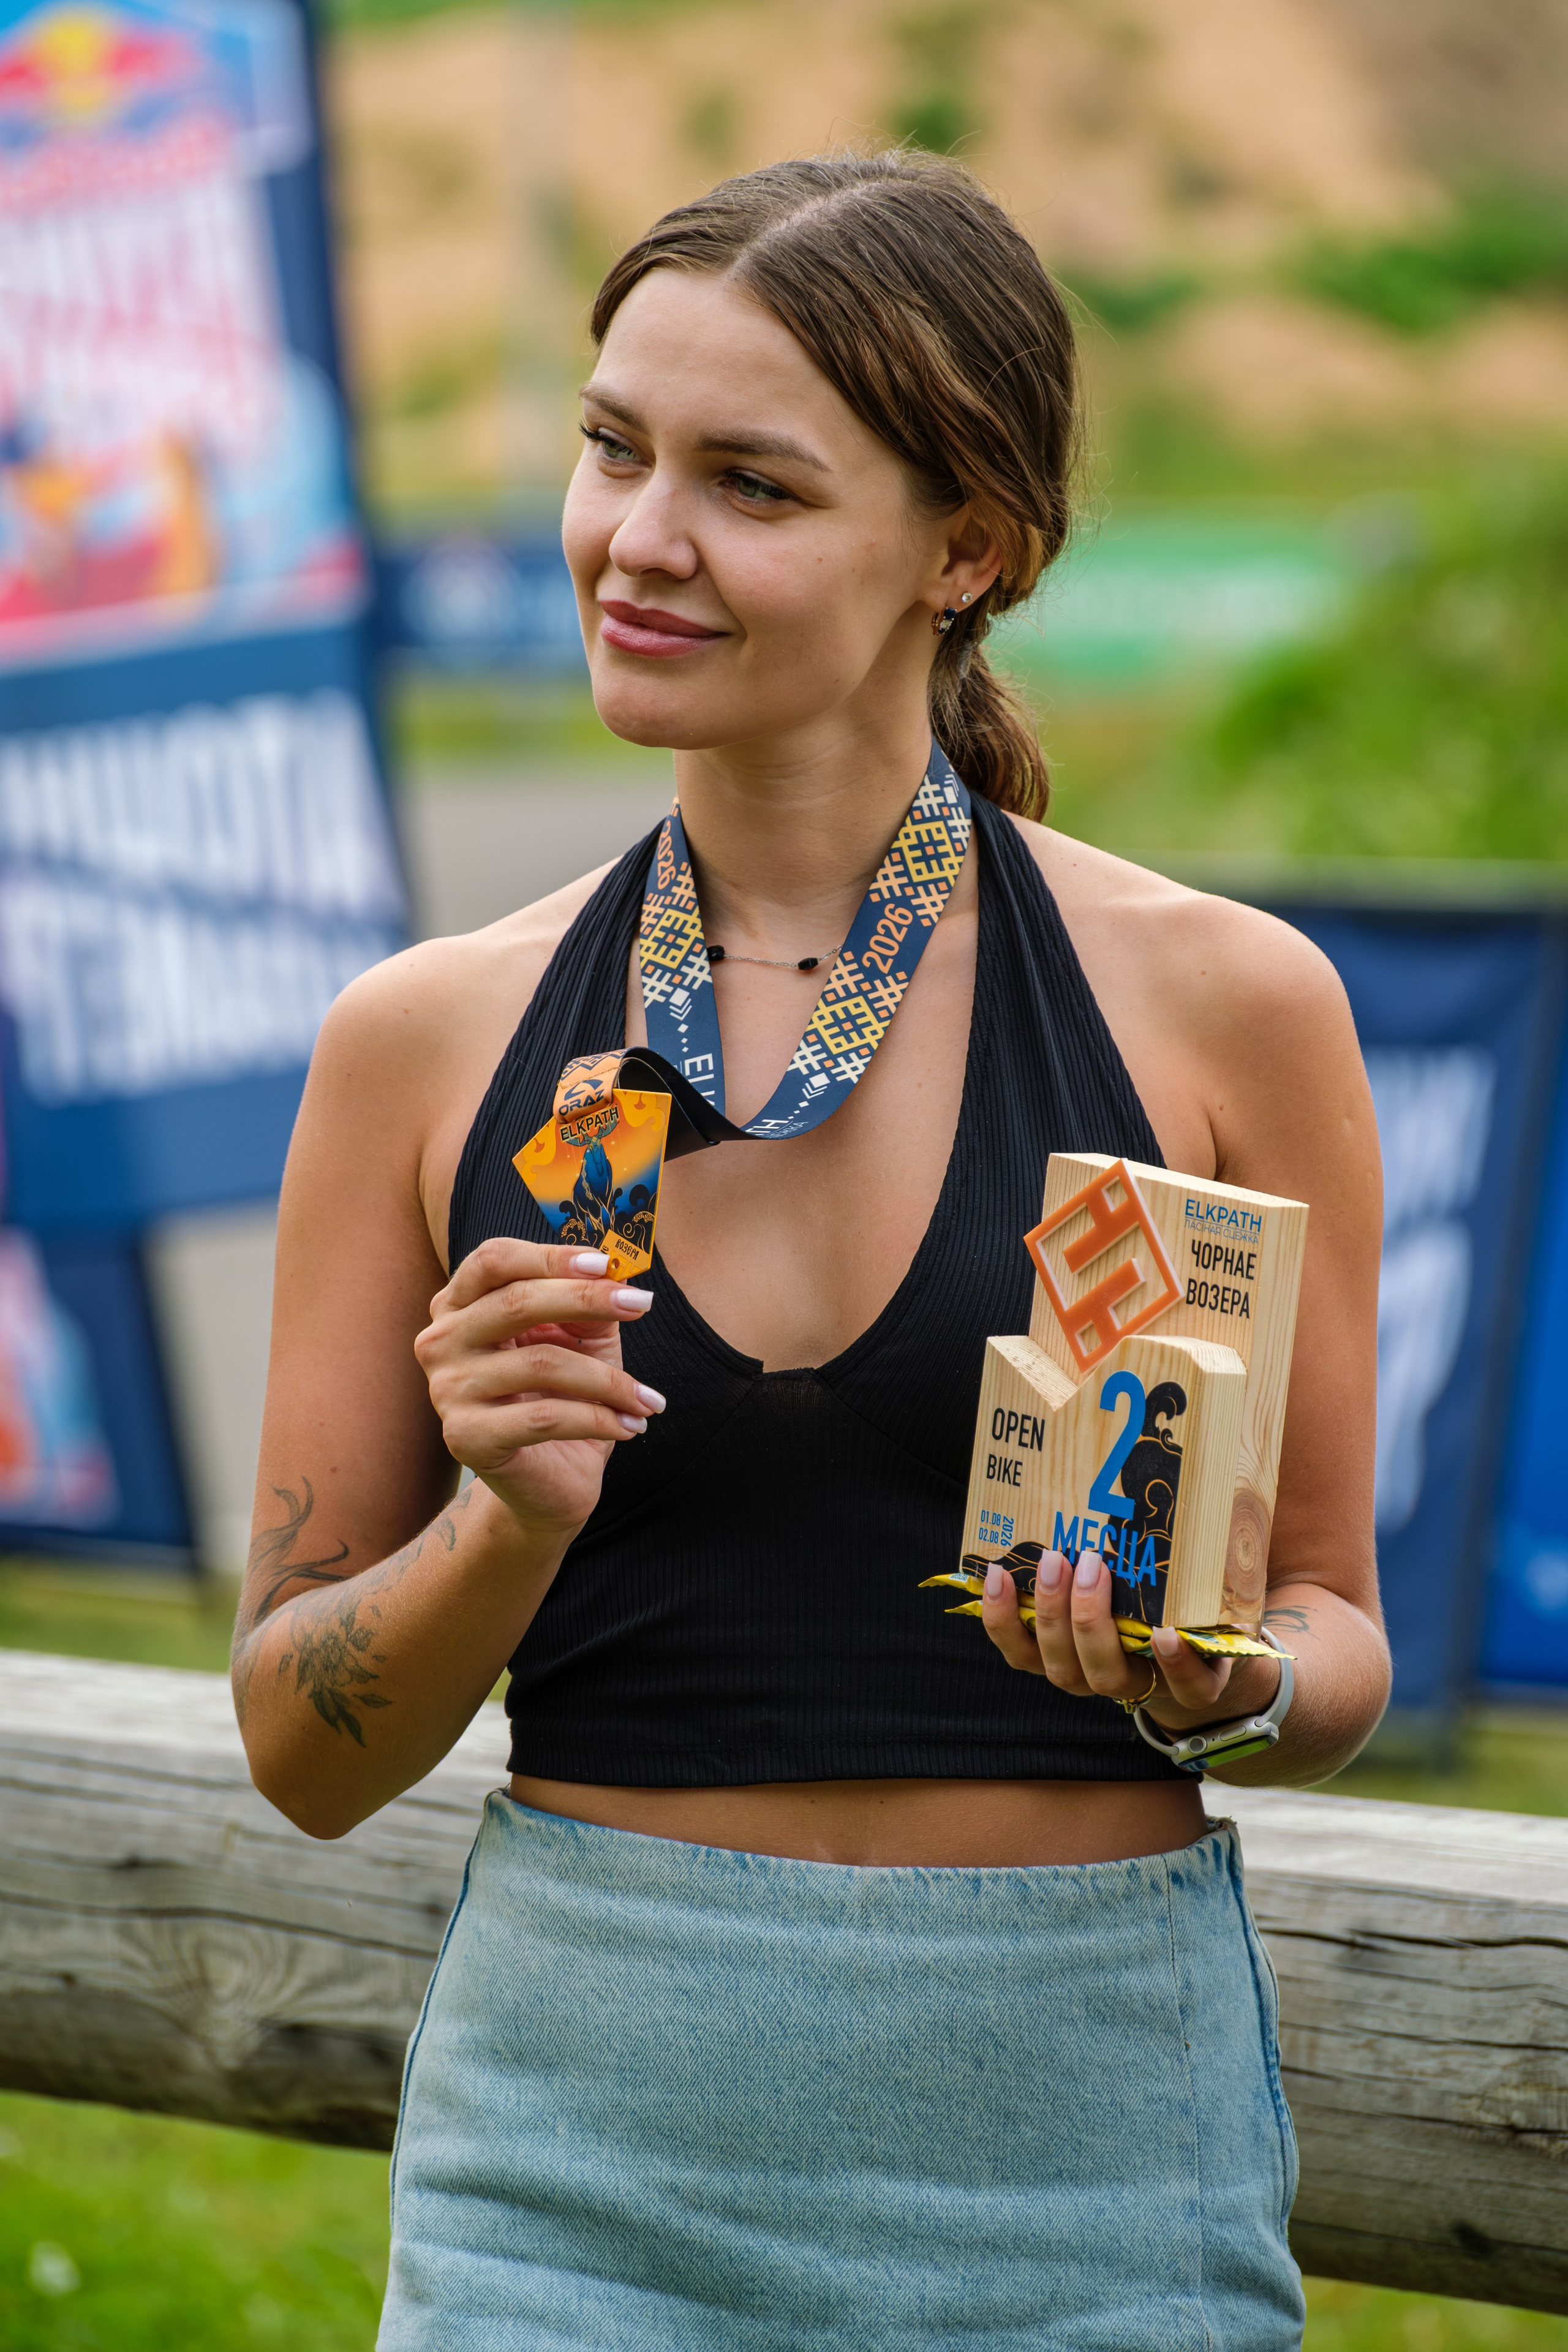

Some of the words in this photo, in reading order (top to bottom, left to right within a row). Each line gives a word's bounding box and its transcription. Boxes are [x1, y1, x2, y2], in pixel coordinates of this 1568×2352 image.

[657, 820, 677, 890] 2026
[862, 903, 913, 974] 2026
[559, 1088, 605, 1116] ORAZ
[560, 1105, 619, 1141] ELKPATH
[1185, 1198, 1262, 1232] ELKPATH
[1223, 1228, 1259, 1245] СЦЕЖКА
[1191, 1239, 1257, 1280] ЧОРНАЕ
[1186, 1278, 1250, 1319] ВОЗЕРА
[992, 1407, 1046, 1452] OPEN
[1088, 1370, 1147, 1520] 2
[986, 1453, 1023, 1487] BIKE
[981, 1509, 1001, 1526] 01.08
[1000, 1515, 1015, 1547] 2026
[978, 1527, 1000, 1544] 02.08
